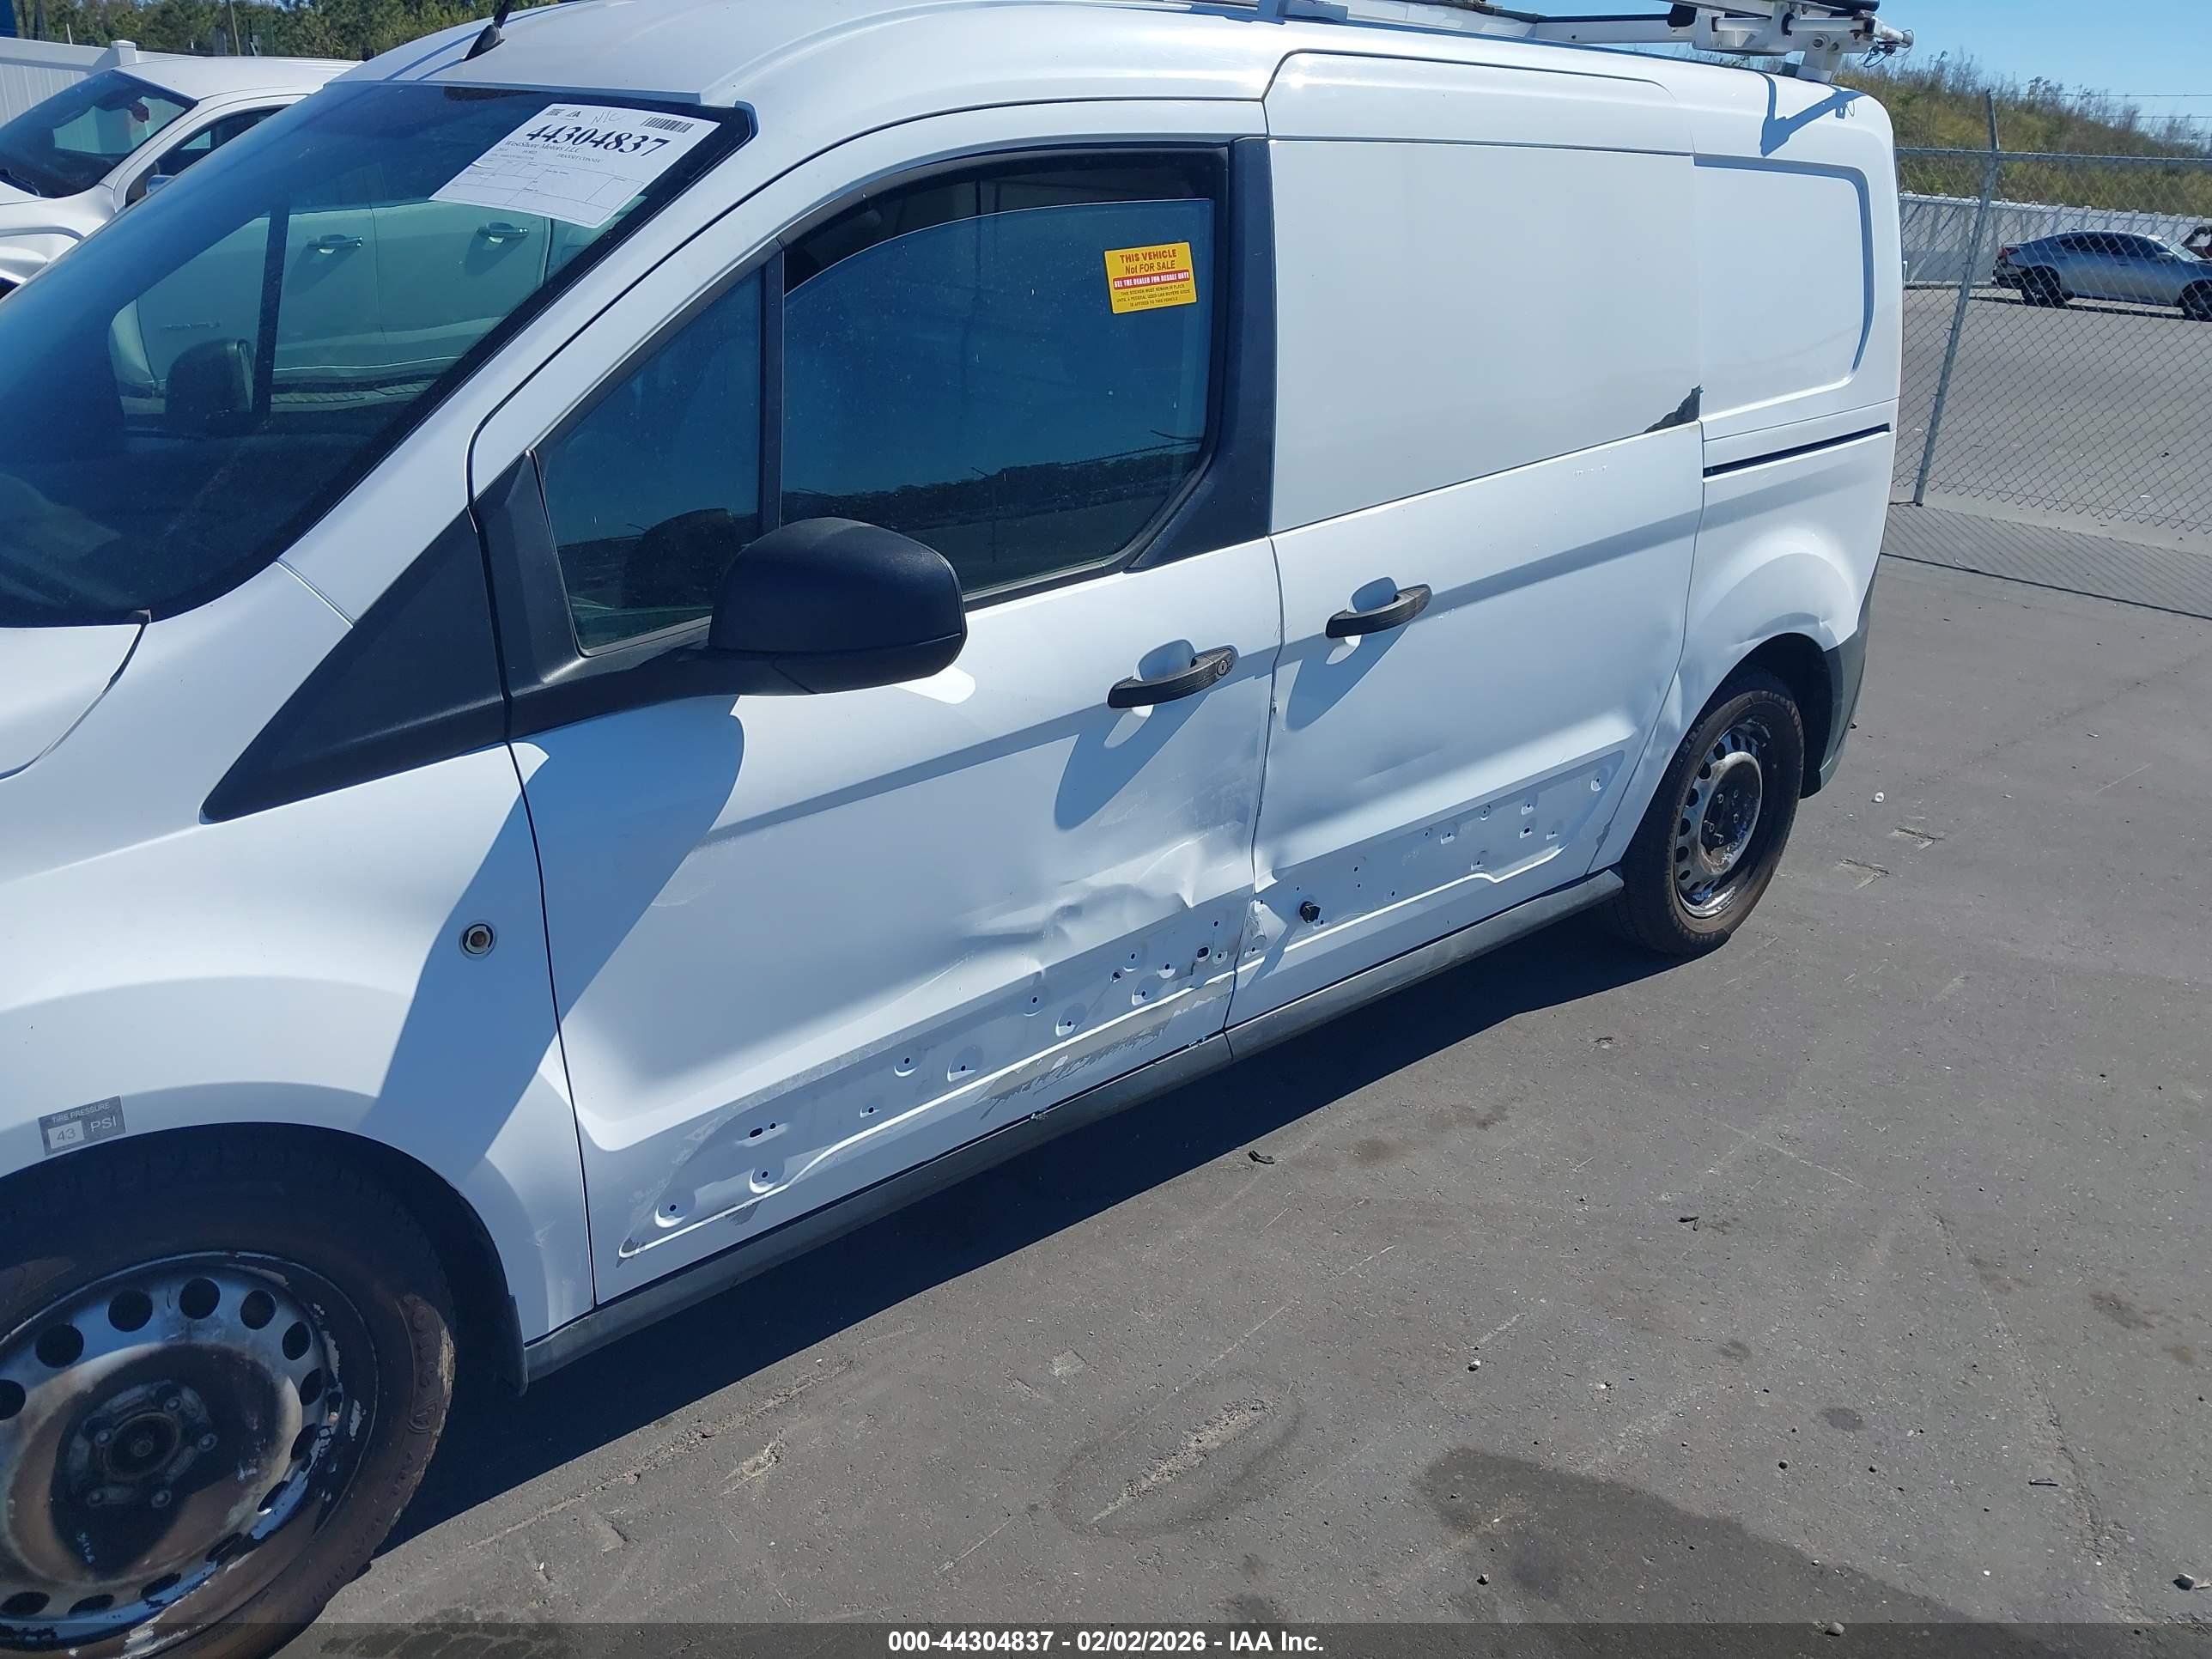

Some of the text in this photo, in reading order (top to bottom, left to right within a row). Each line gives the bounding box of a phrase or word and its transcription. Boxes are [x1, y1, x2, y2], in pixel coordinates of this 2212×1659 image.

[505, 140, 539, 149] WestShore
[526, 124, 672, 156] 44304837
[1120, 249, 1177, 264] THIS VEHICLE
[1125, 260, 1176, 275] Not FOR SALE
[1124, 278, 1133, 287] THE
[1133, 276, 1151, 285] DEALER
[52, 1102, 111, 1123] TIRE PRESSURE
[57, 1115, 117, 1141] 43 PSI
